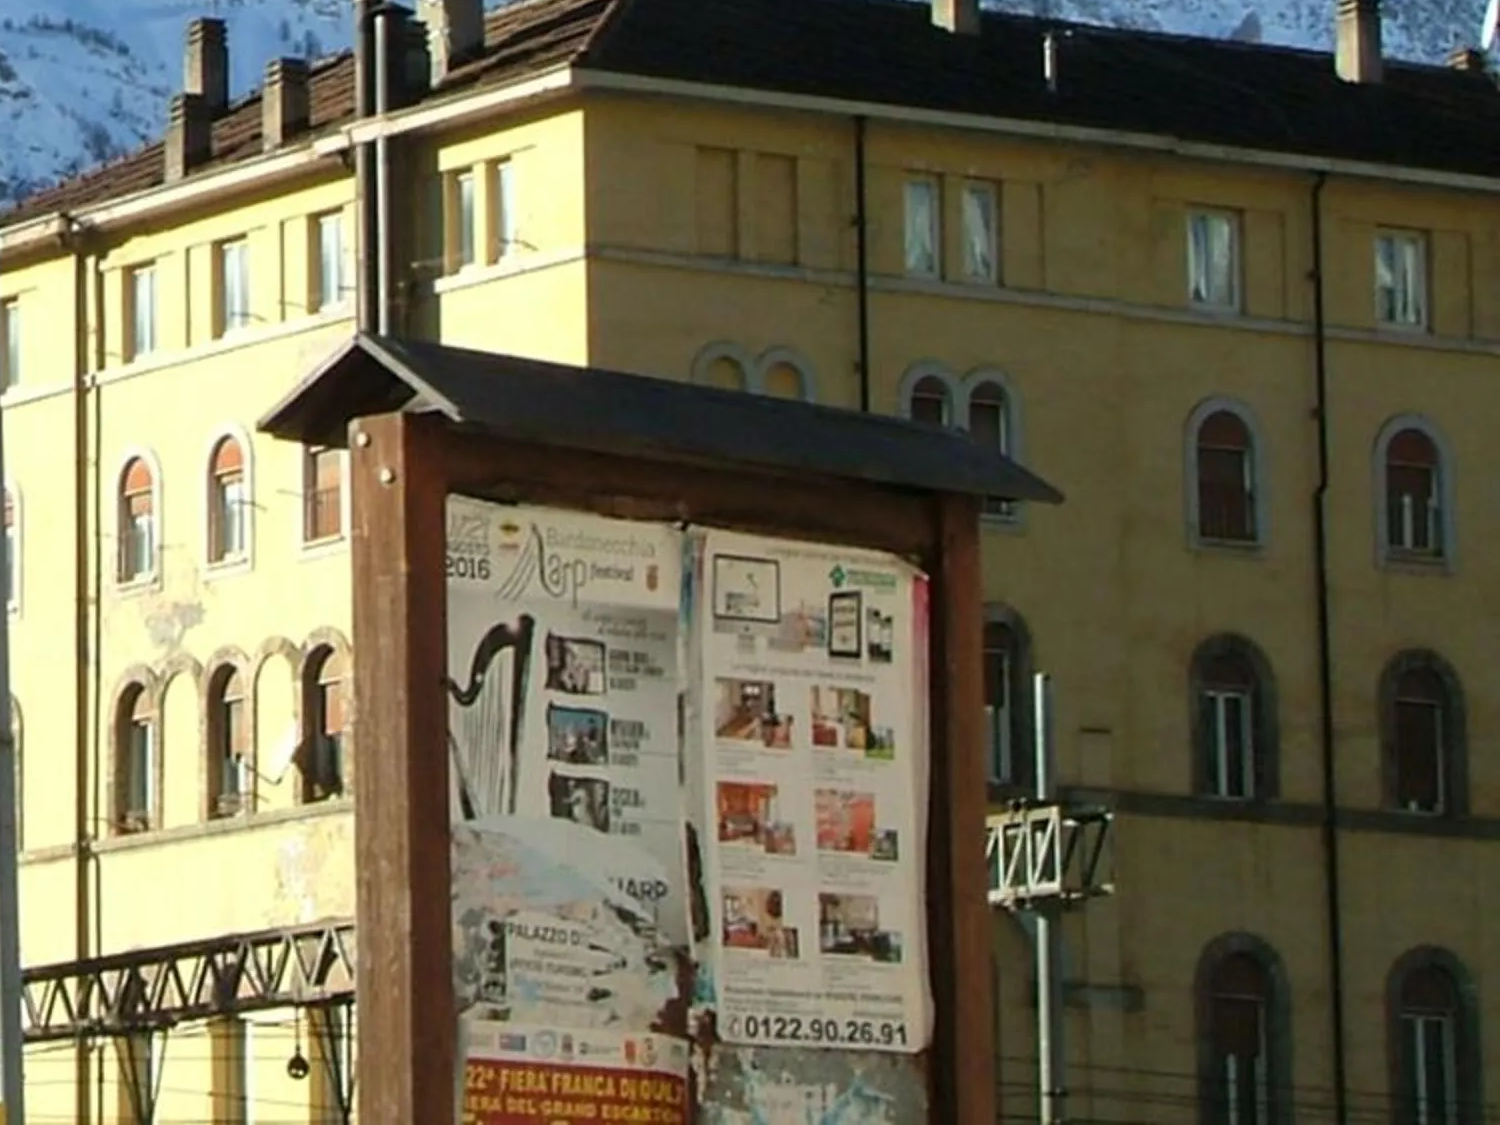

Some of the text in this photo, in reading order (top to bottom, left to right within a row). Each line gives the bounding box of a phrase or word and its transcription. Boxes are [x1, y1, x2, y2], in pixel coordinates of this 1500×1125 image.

[444, 554, 491, 581] 2016
[745, 1015, 908, 1046] 0122.90.26.91
[500, 1068, 547, 1094] FIERA
[552, 1071, 616, 1097] FRANCA
[505, 1096, 537, 1115] DEL
